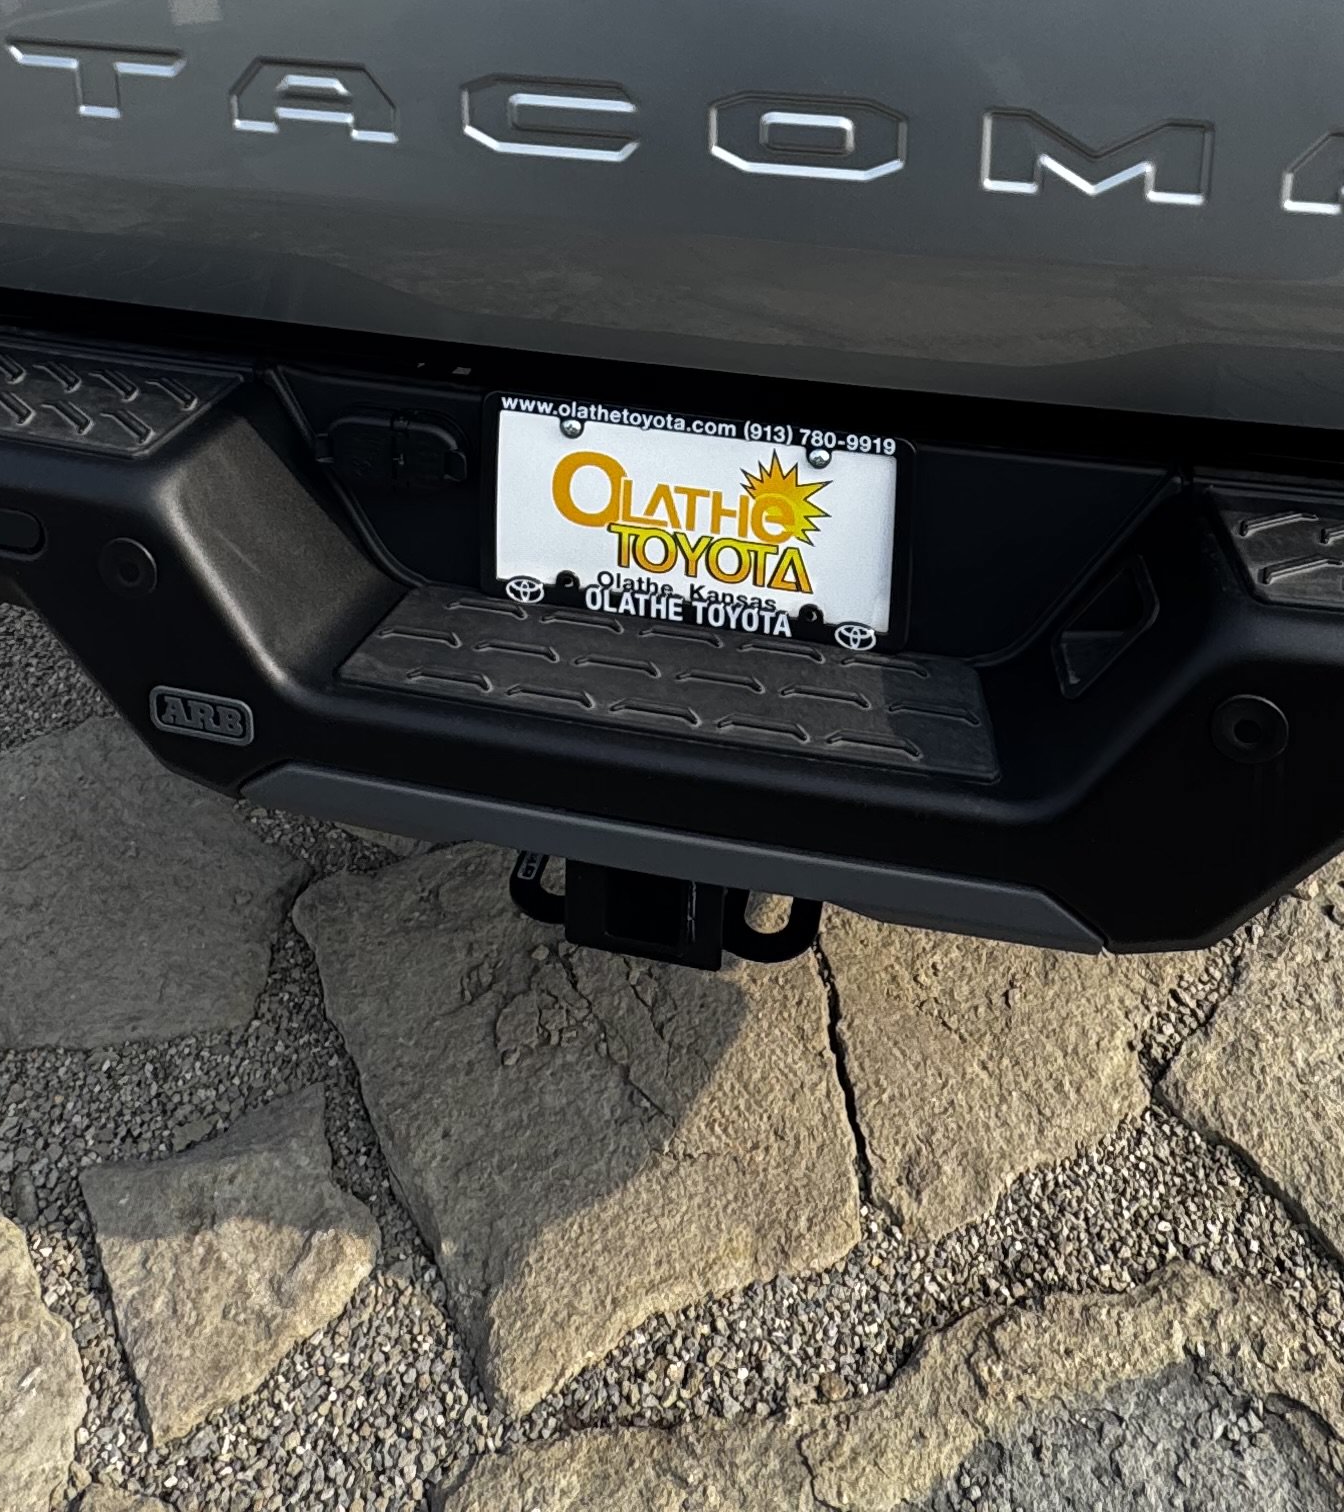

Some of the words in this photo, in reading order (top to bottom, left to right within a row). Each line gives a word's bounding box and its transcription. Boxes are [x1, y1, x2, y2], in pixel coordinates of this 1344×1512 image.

[501, 396, 737, 437] www.olathetoyota.com
[744, 421, 793, 445] (913)
[800, 429, 896, 455] 780-9919
[607, 523, 813, 594] TOYOTA
[585, 587, 684, 621] OLATHE
[692, 599, 792, 637] TOYOTA
[161, 696, 244, 737] ARB
